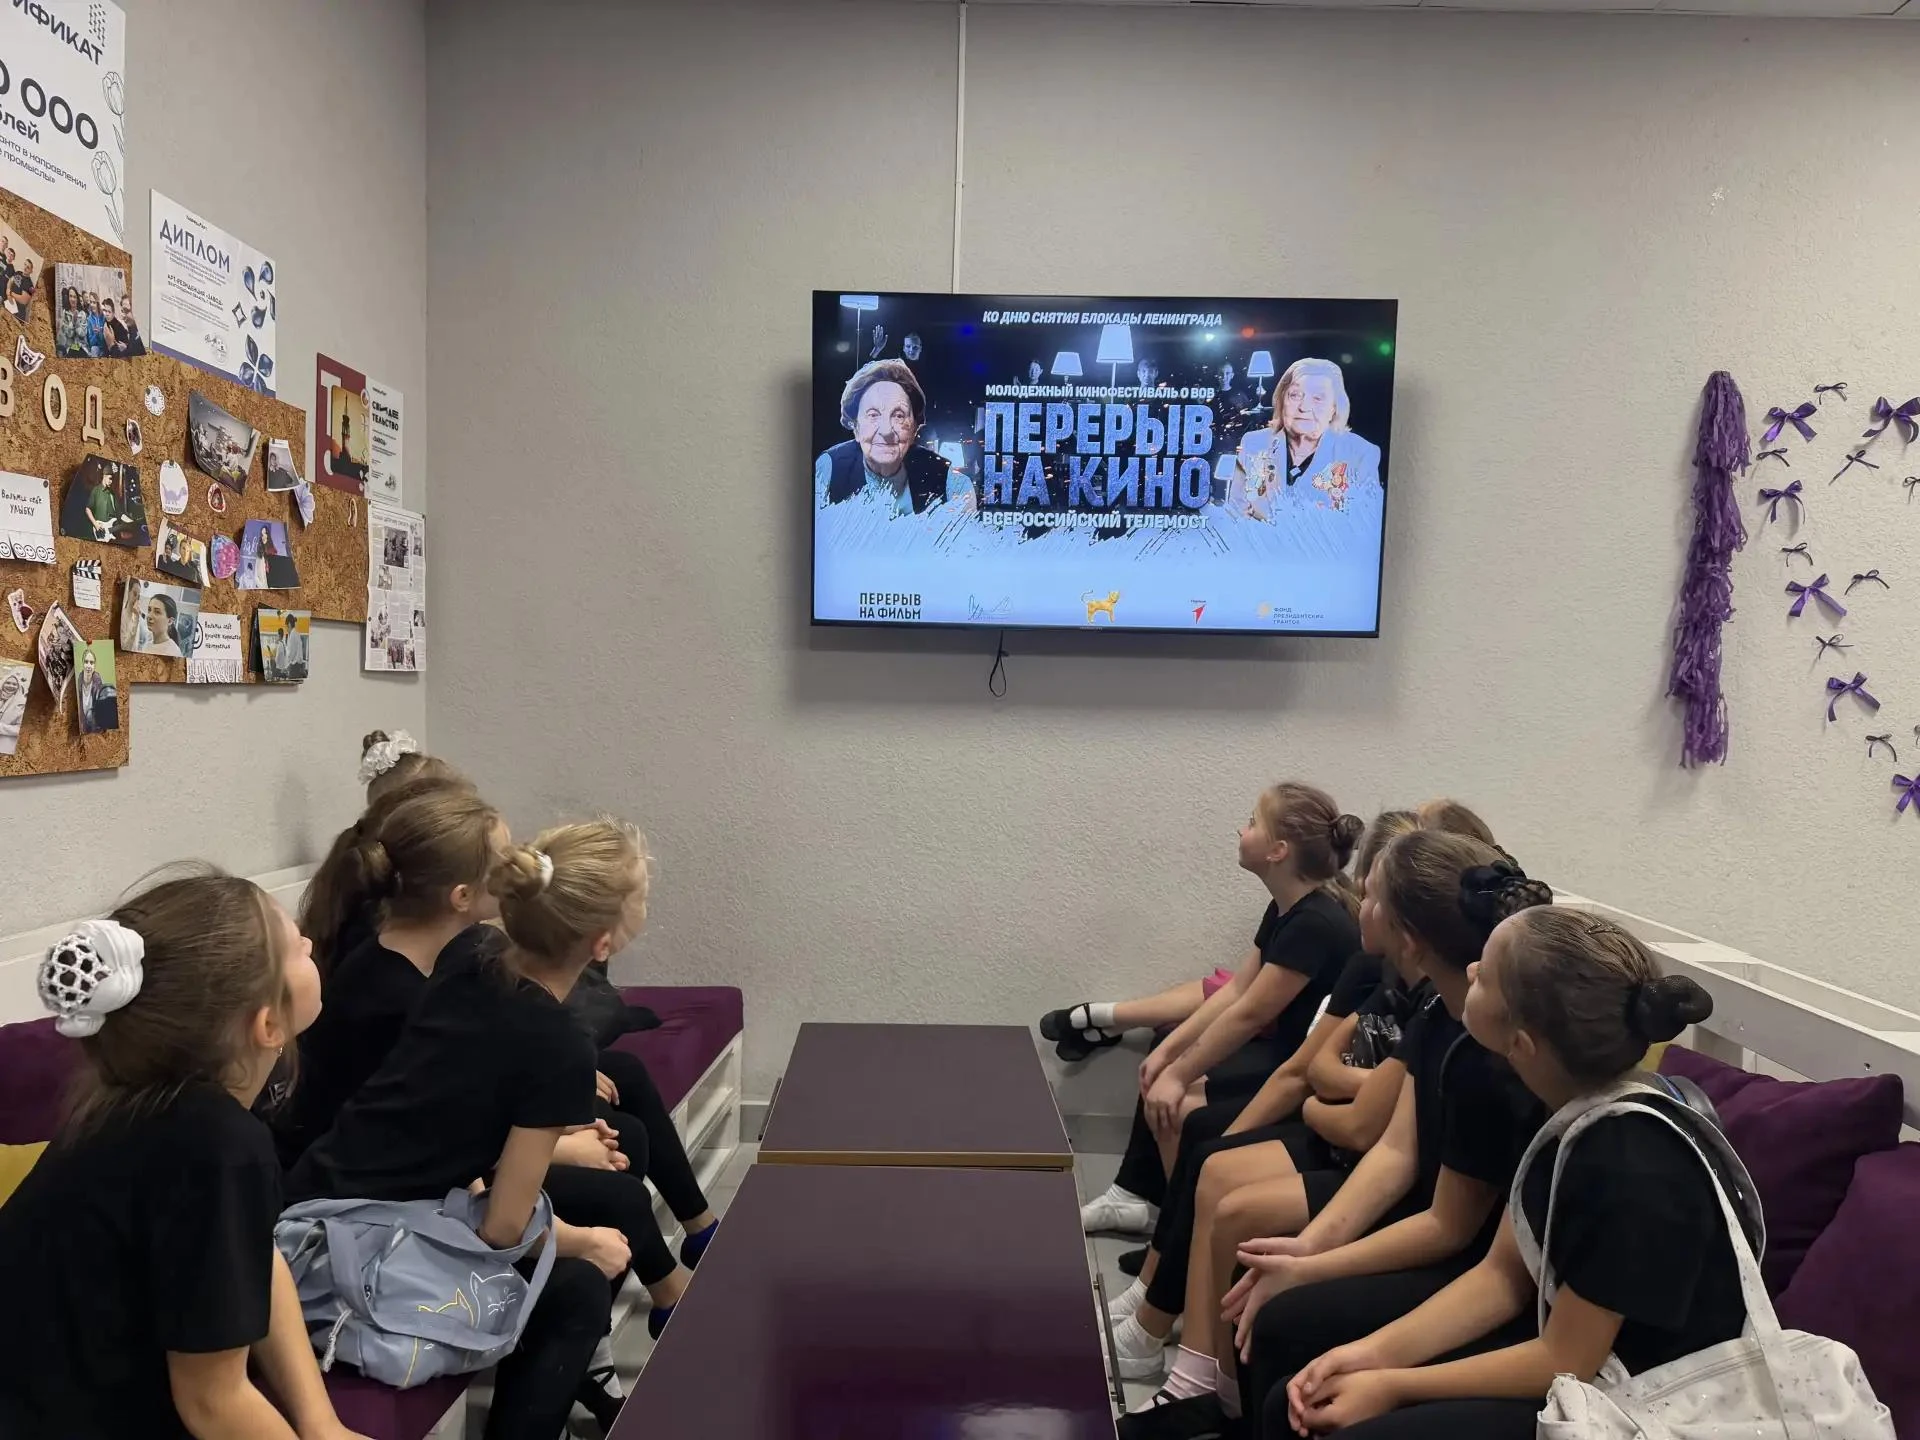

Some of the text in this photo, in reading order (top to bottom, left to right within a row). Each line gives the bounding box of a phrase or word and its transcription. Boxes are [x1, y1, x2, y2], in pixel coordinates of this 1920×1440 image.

[0, 103, 39, 144] лей
[30, 152, 87, 190] направлении
[160, 219, 230, 273] ДИПЛОМ
[983, 311, 1223, 327] КО ДНЮ СНЯТИЯ БЛОКАДЫ ЛЕНИНГРАДА
[985, 384, 1215, 399] МОЛОДЕЖНЫЙ КИНОФЕСТИВАЛЬ О ВОВ
[984, 402, 1214, 455] ПЕРЕРЫВ
[984, 454, 1211, 509] НА КИНО
[983, 510, 1209, 530] ВСЕРОССИЙСКИЙ ТЕЛЕМОСТ
[859, 592, 921, 605] ПЕРЕРЫВ
[859, 607, 921, 620] НА ФИЛЬМ
